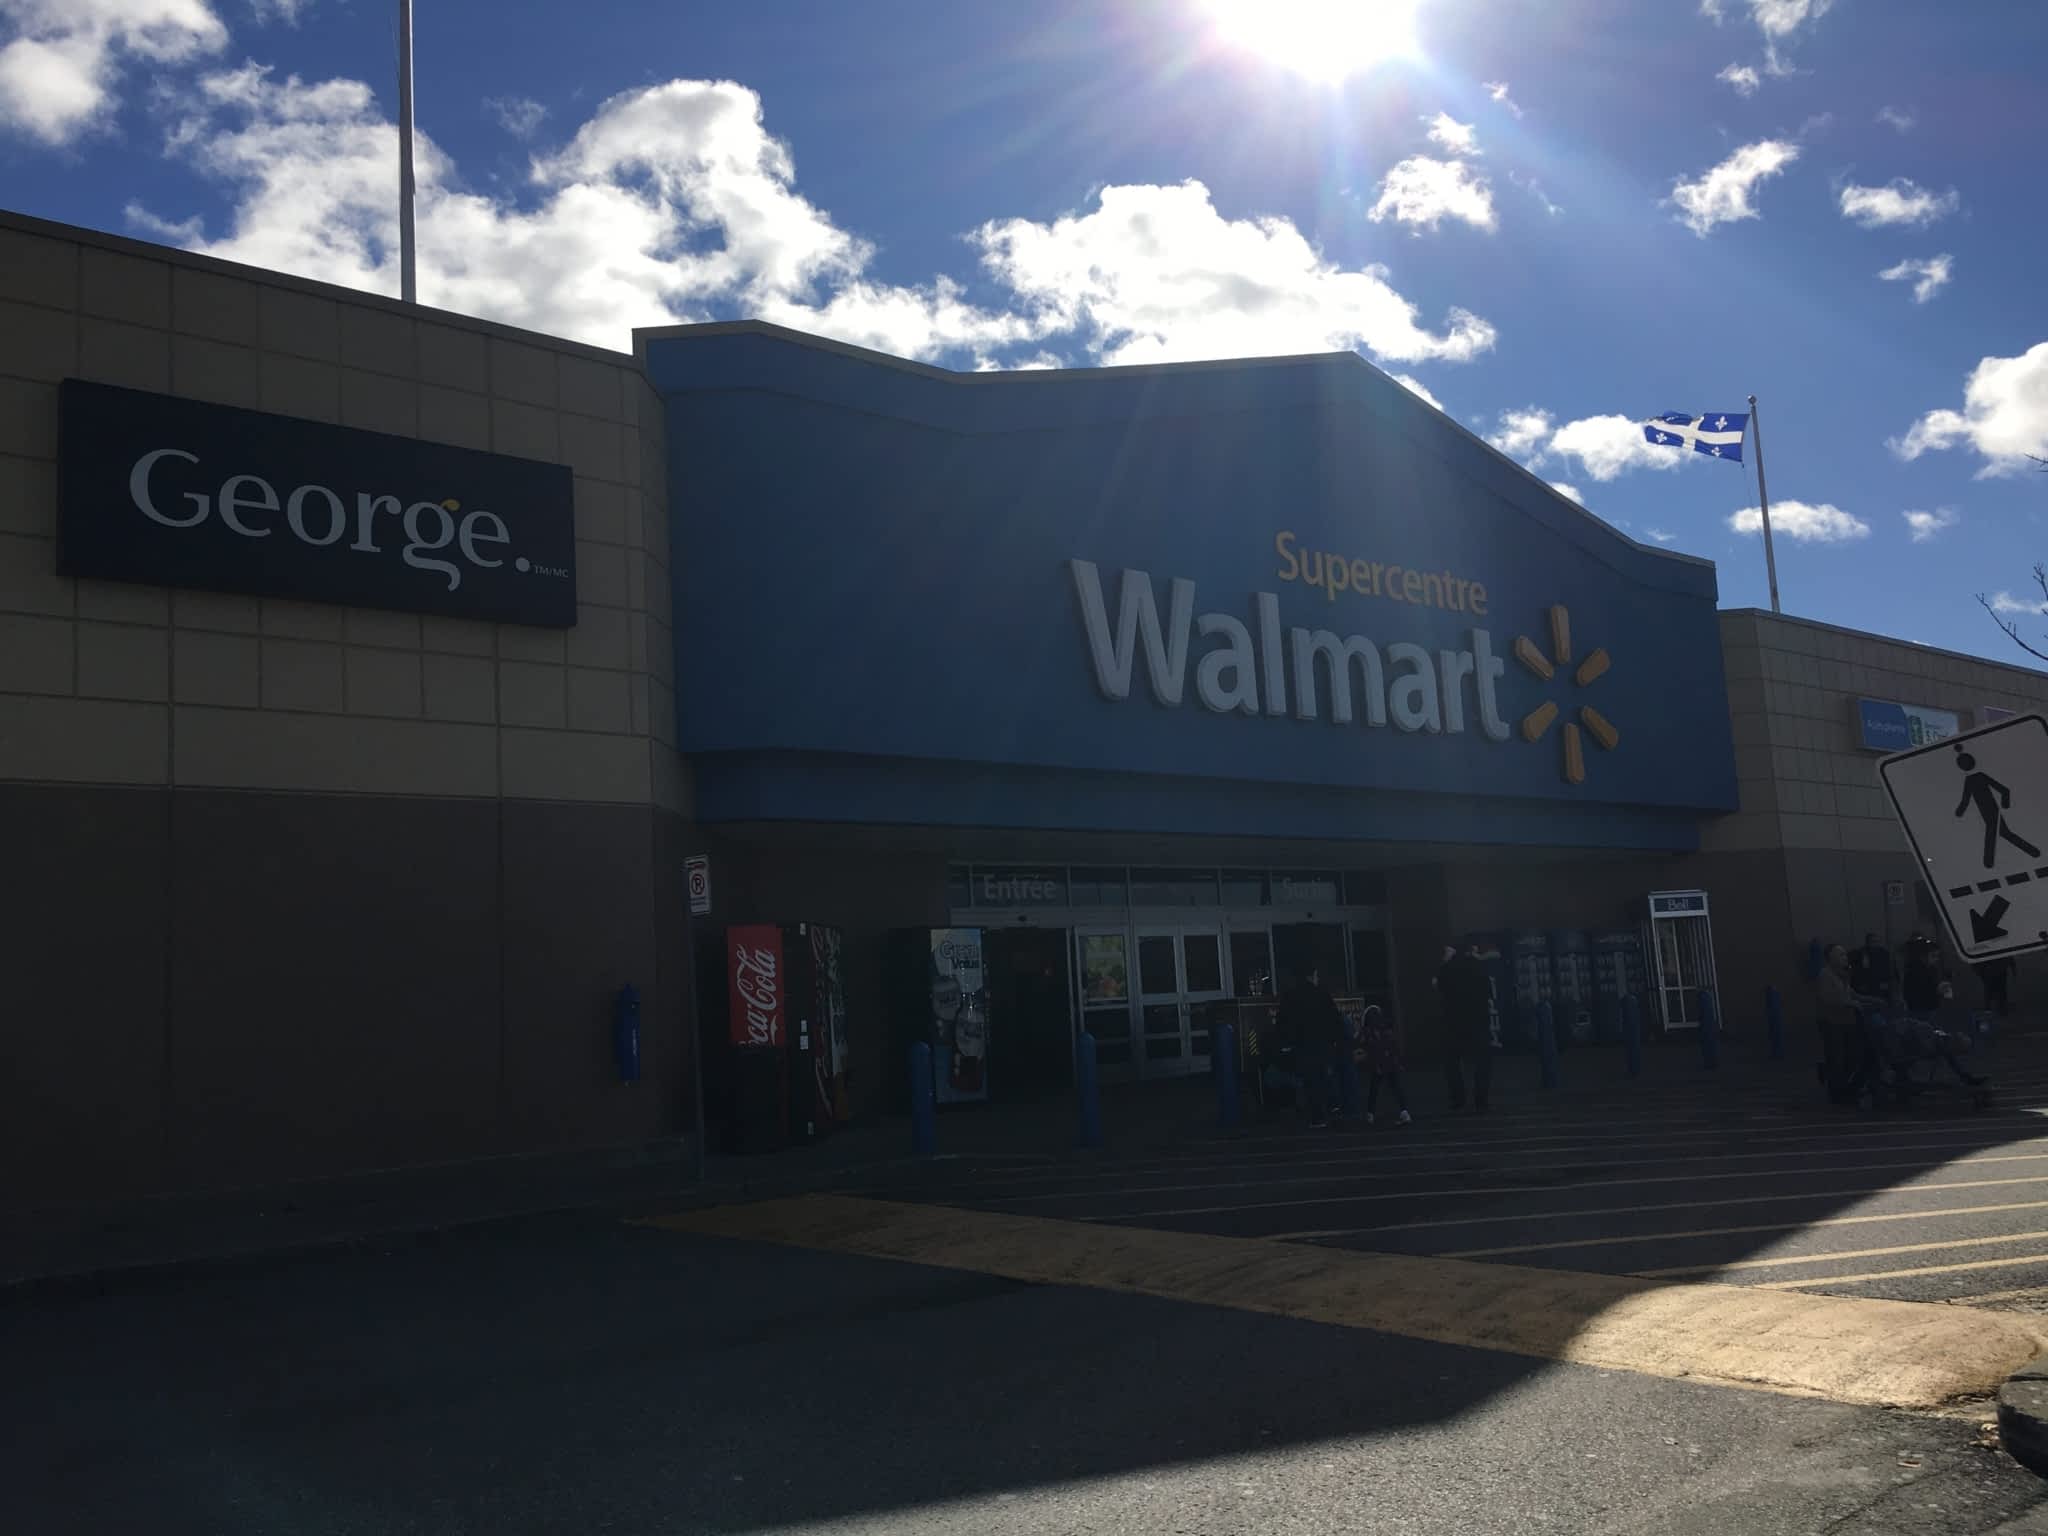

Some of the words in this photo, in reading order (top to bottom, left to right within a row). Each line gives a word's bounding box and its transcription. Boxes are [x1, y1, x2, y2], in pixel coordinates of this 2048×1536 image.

[1276, 530, 1489, 616] Supercentre
[1070, 558, 1511, 741] Walmart
[984, 872, 1057, 900] Entrée
[1668, 898, 1689, 911] Bell
